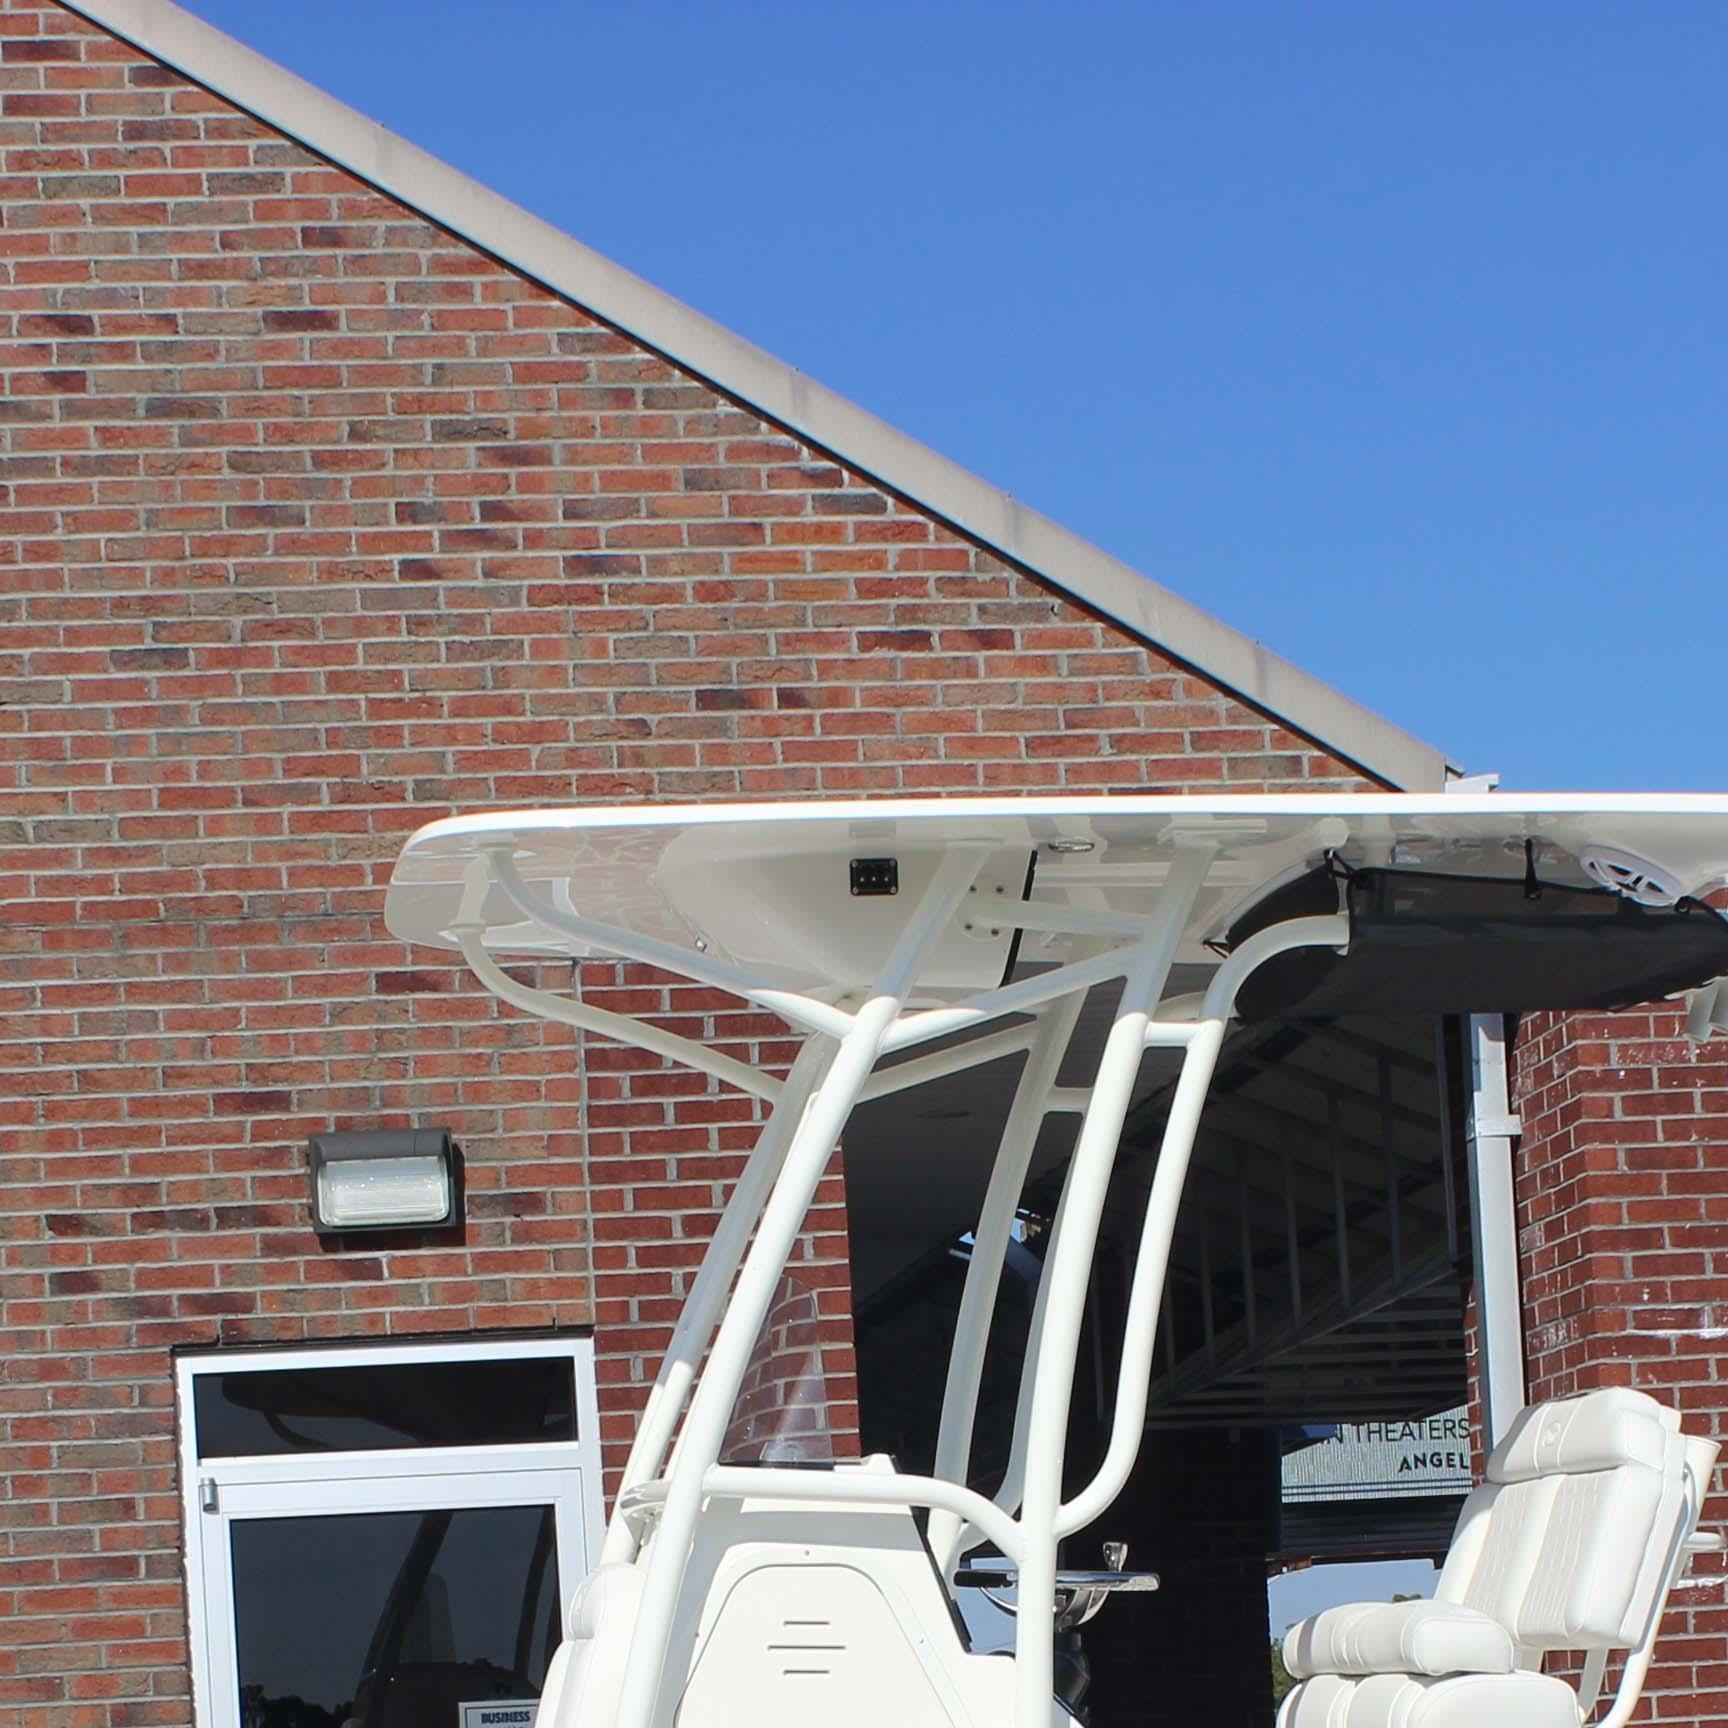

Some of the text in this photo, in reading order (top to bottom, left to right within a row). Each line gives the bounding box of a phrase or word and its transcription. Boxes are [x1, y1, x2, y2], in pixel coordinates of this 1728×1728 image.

[1353, 1418, 1470, 1444] THEATERS
[1399, 1452, 1470, 1472] ANGEL
[481, 1711, 531, 1724] BUSINESS
